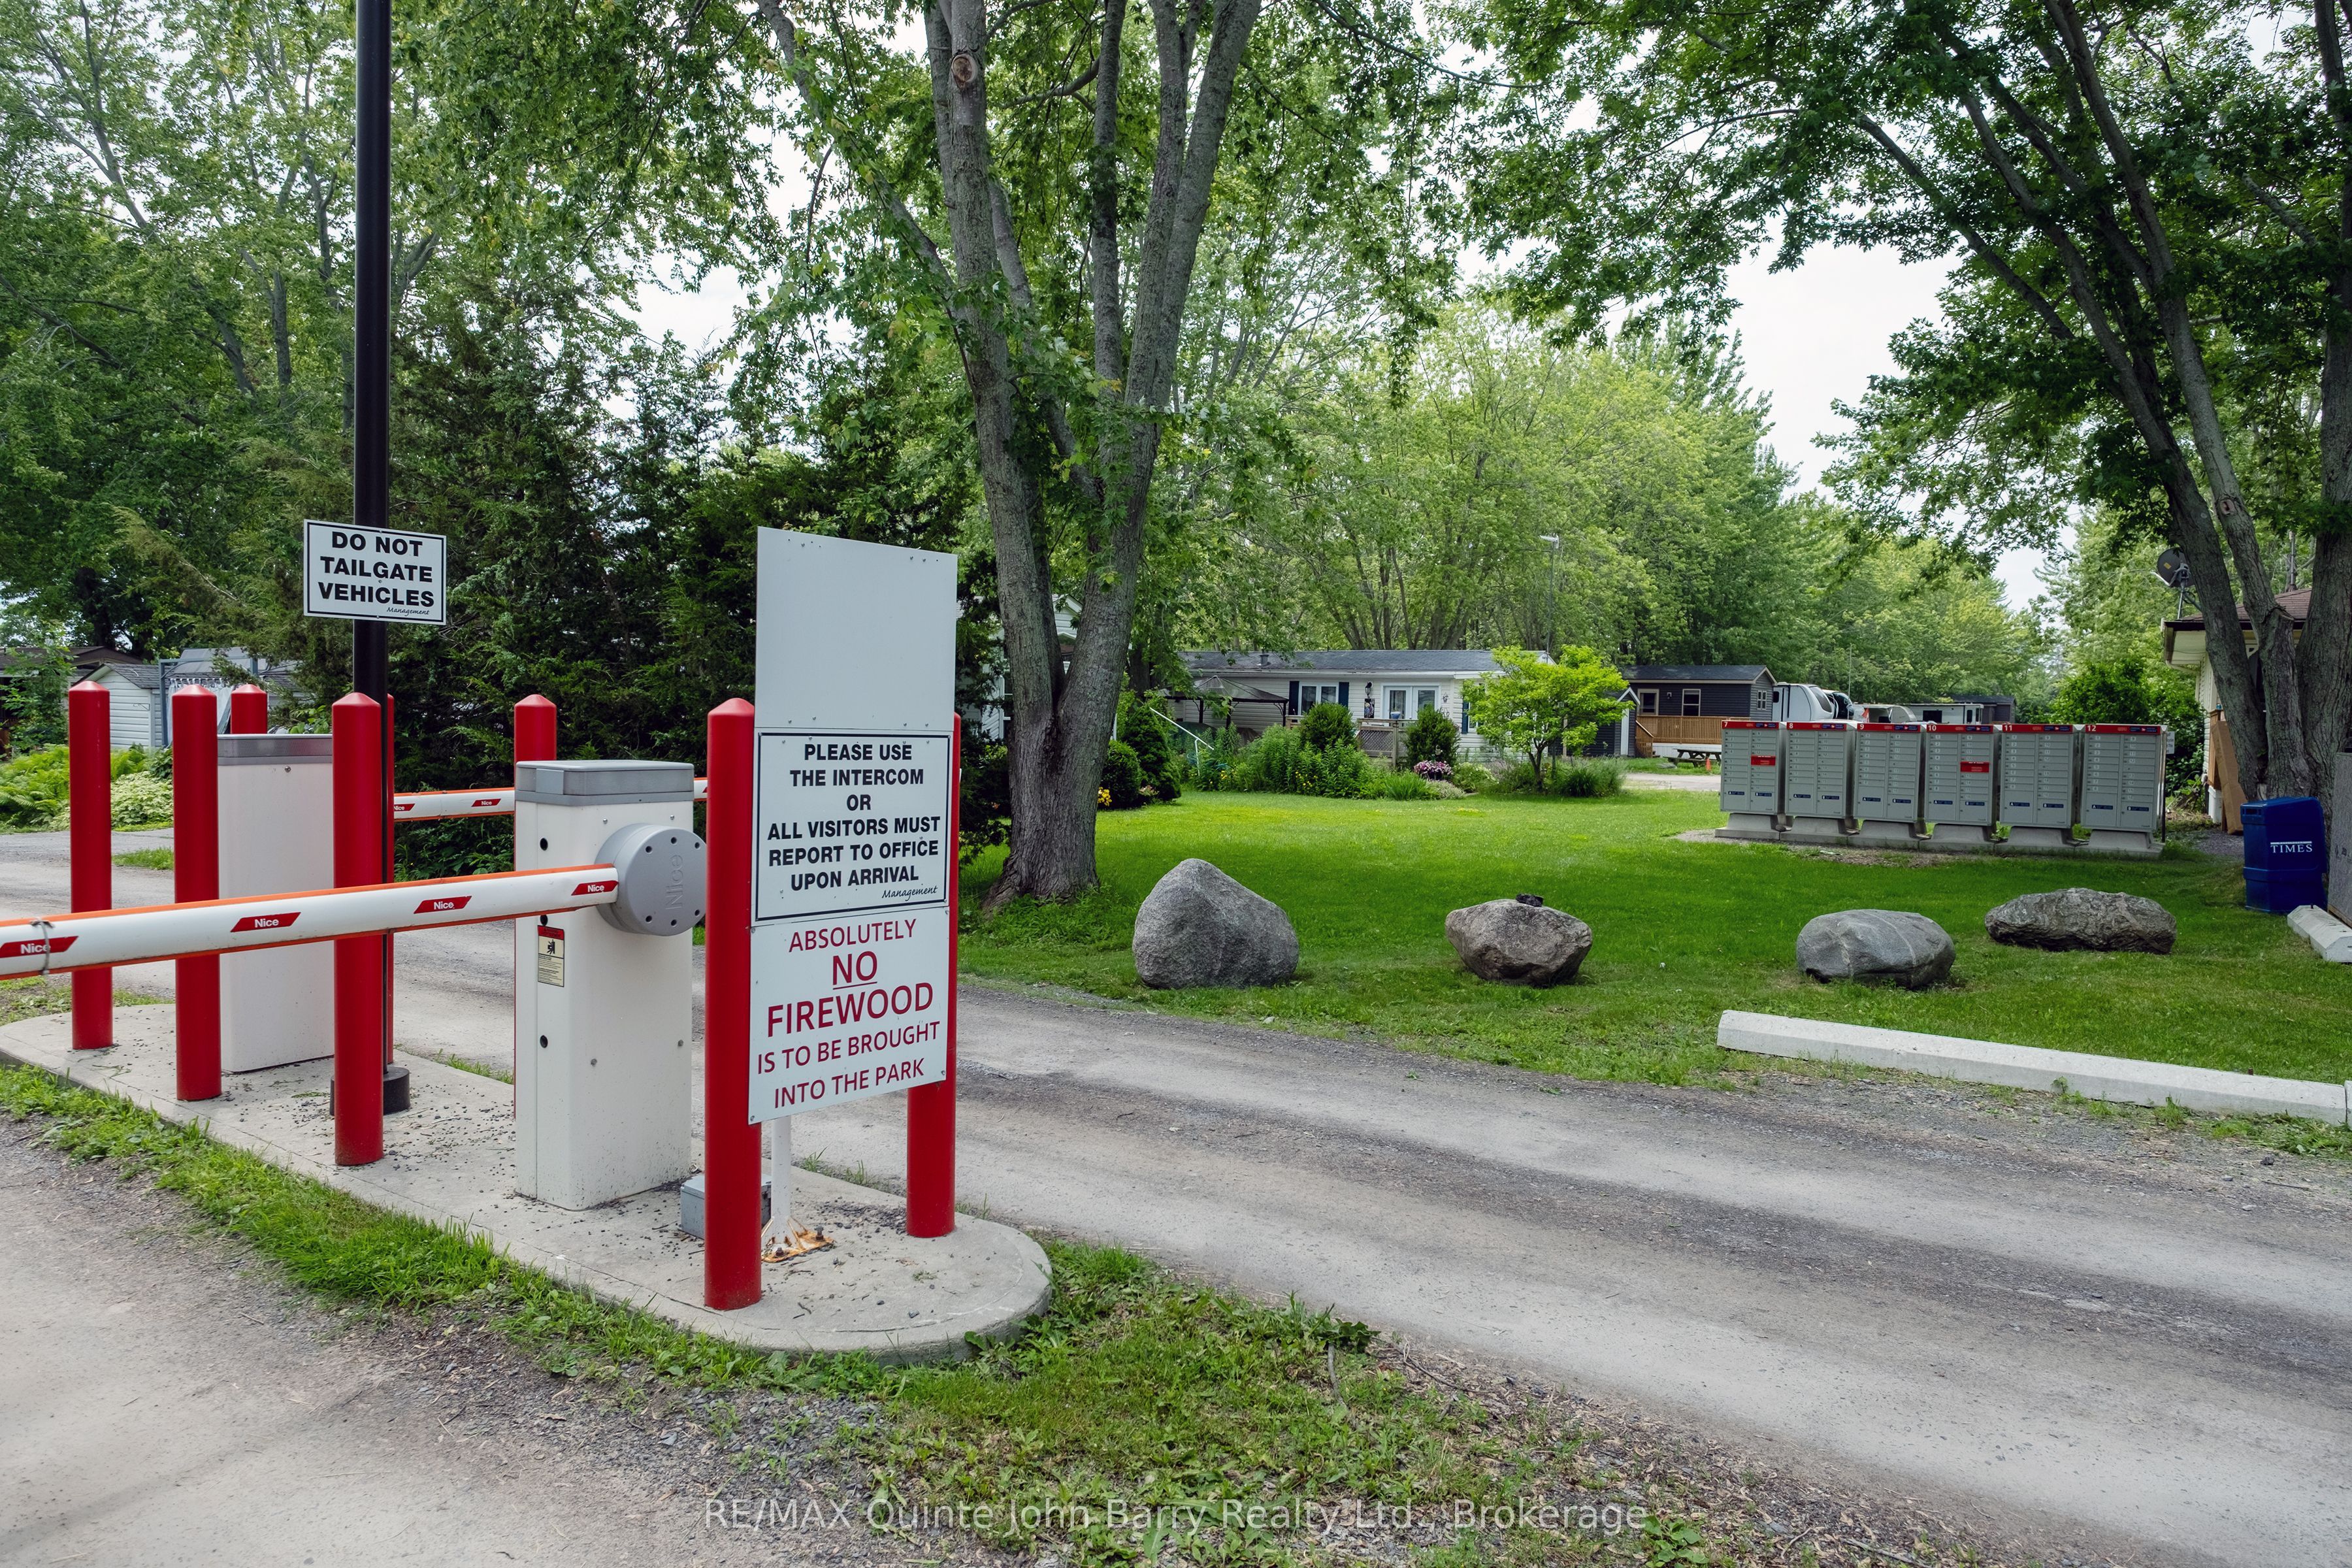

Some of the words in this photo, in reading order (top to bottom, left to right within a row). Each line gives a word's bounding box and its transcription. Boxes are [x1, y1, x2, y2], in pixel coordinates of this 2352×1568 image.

[332, 531, 366, 551] DO
[376, 536, 423, 557] NOT
[320, 556, 433, 582] TAILGATE
[318, 581, 434, 607] VEHICLES
[387, 607, 429, 616] Management
[804, 743, 873, 760] PLEASE
[879, 744, 912, 760] USE
[790, 770, 826, 787] THE
[833, 769, 924, 786] INTERCOM
[847, 794, 871, 811] OR
[768, 822, 802, 840] ALL
[808, 818, 889, 838] VISITORS
[894, 816, 940, 833] MUST
[769, 845, 843, 866] REPORT
[850, 843, 873, 860] TO
[879, 840, 938, 858] OFFICE
[2270, 844, 2313, 853] TIMES
[665, 855, 683, 909] Nice
[791, 871, 841, 891] UPON
[847, 865, 919, 886] ARRIVAL
[434, 901, 454, 909] Nice
[882, 885, 938, 902] Management
[254, 917, 279, 928] Nice
[20, 943, 51, 955] Nice
[789, 919, 916, 953] ABSOLUTELY
[832, 951, 877, 985] NO
[768, 982, 933, 1037] FIREWOOD
[758, 1051, 776, 1074] IS
[781, 1045, 811, 1069] TO
[818, 1039, 841, 1062] BE
[848, 1021, 940, 1056] BROUGHT
[775, 1079, 825, 1109] INTO
[831, 1069, 870, 1095] THE
[875, 1058, 924, 1086] PARK
